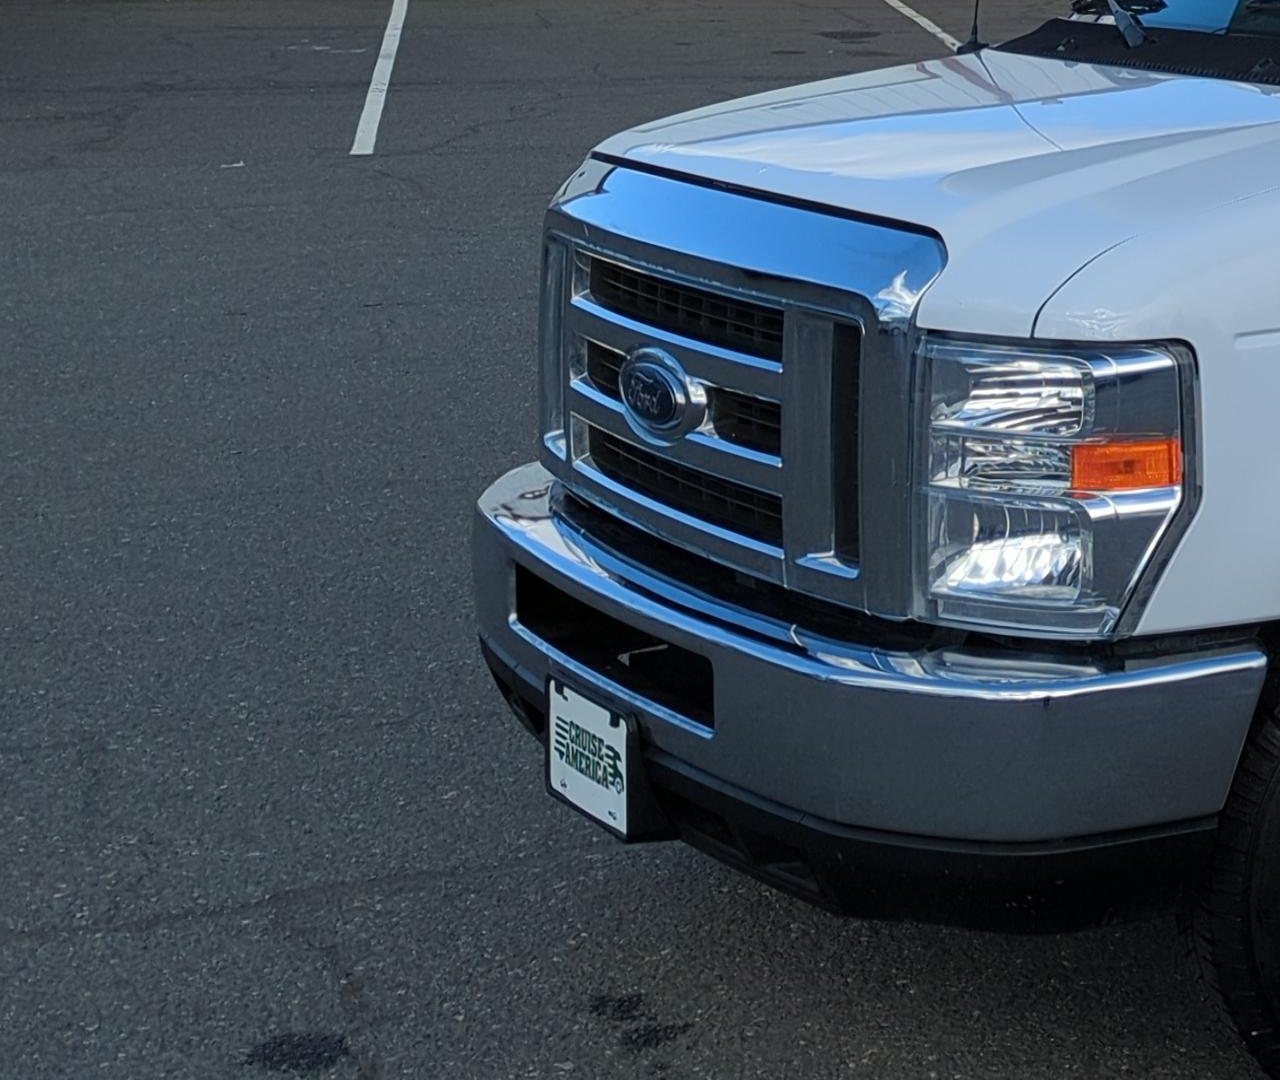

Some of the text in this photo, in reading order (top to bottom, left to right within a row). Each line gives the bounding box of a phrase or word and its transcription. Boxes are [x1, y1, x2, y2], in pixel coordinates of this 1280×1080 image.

[627, 371, 661, 415] Ford
[569, 720, 605, 761] CRUISE
[565, 742, 610, 789] AMERICA
